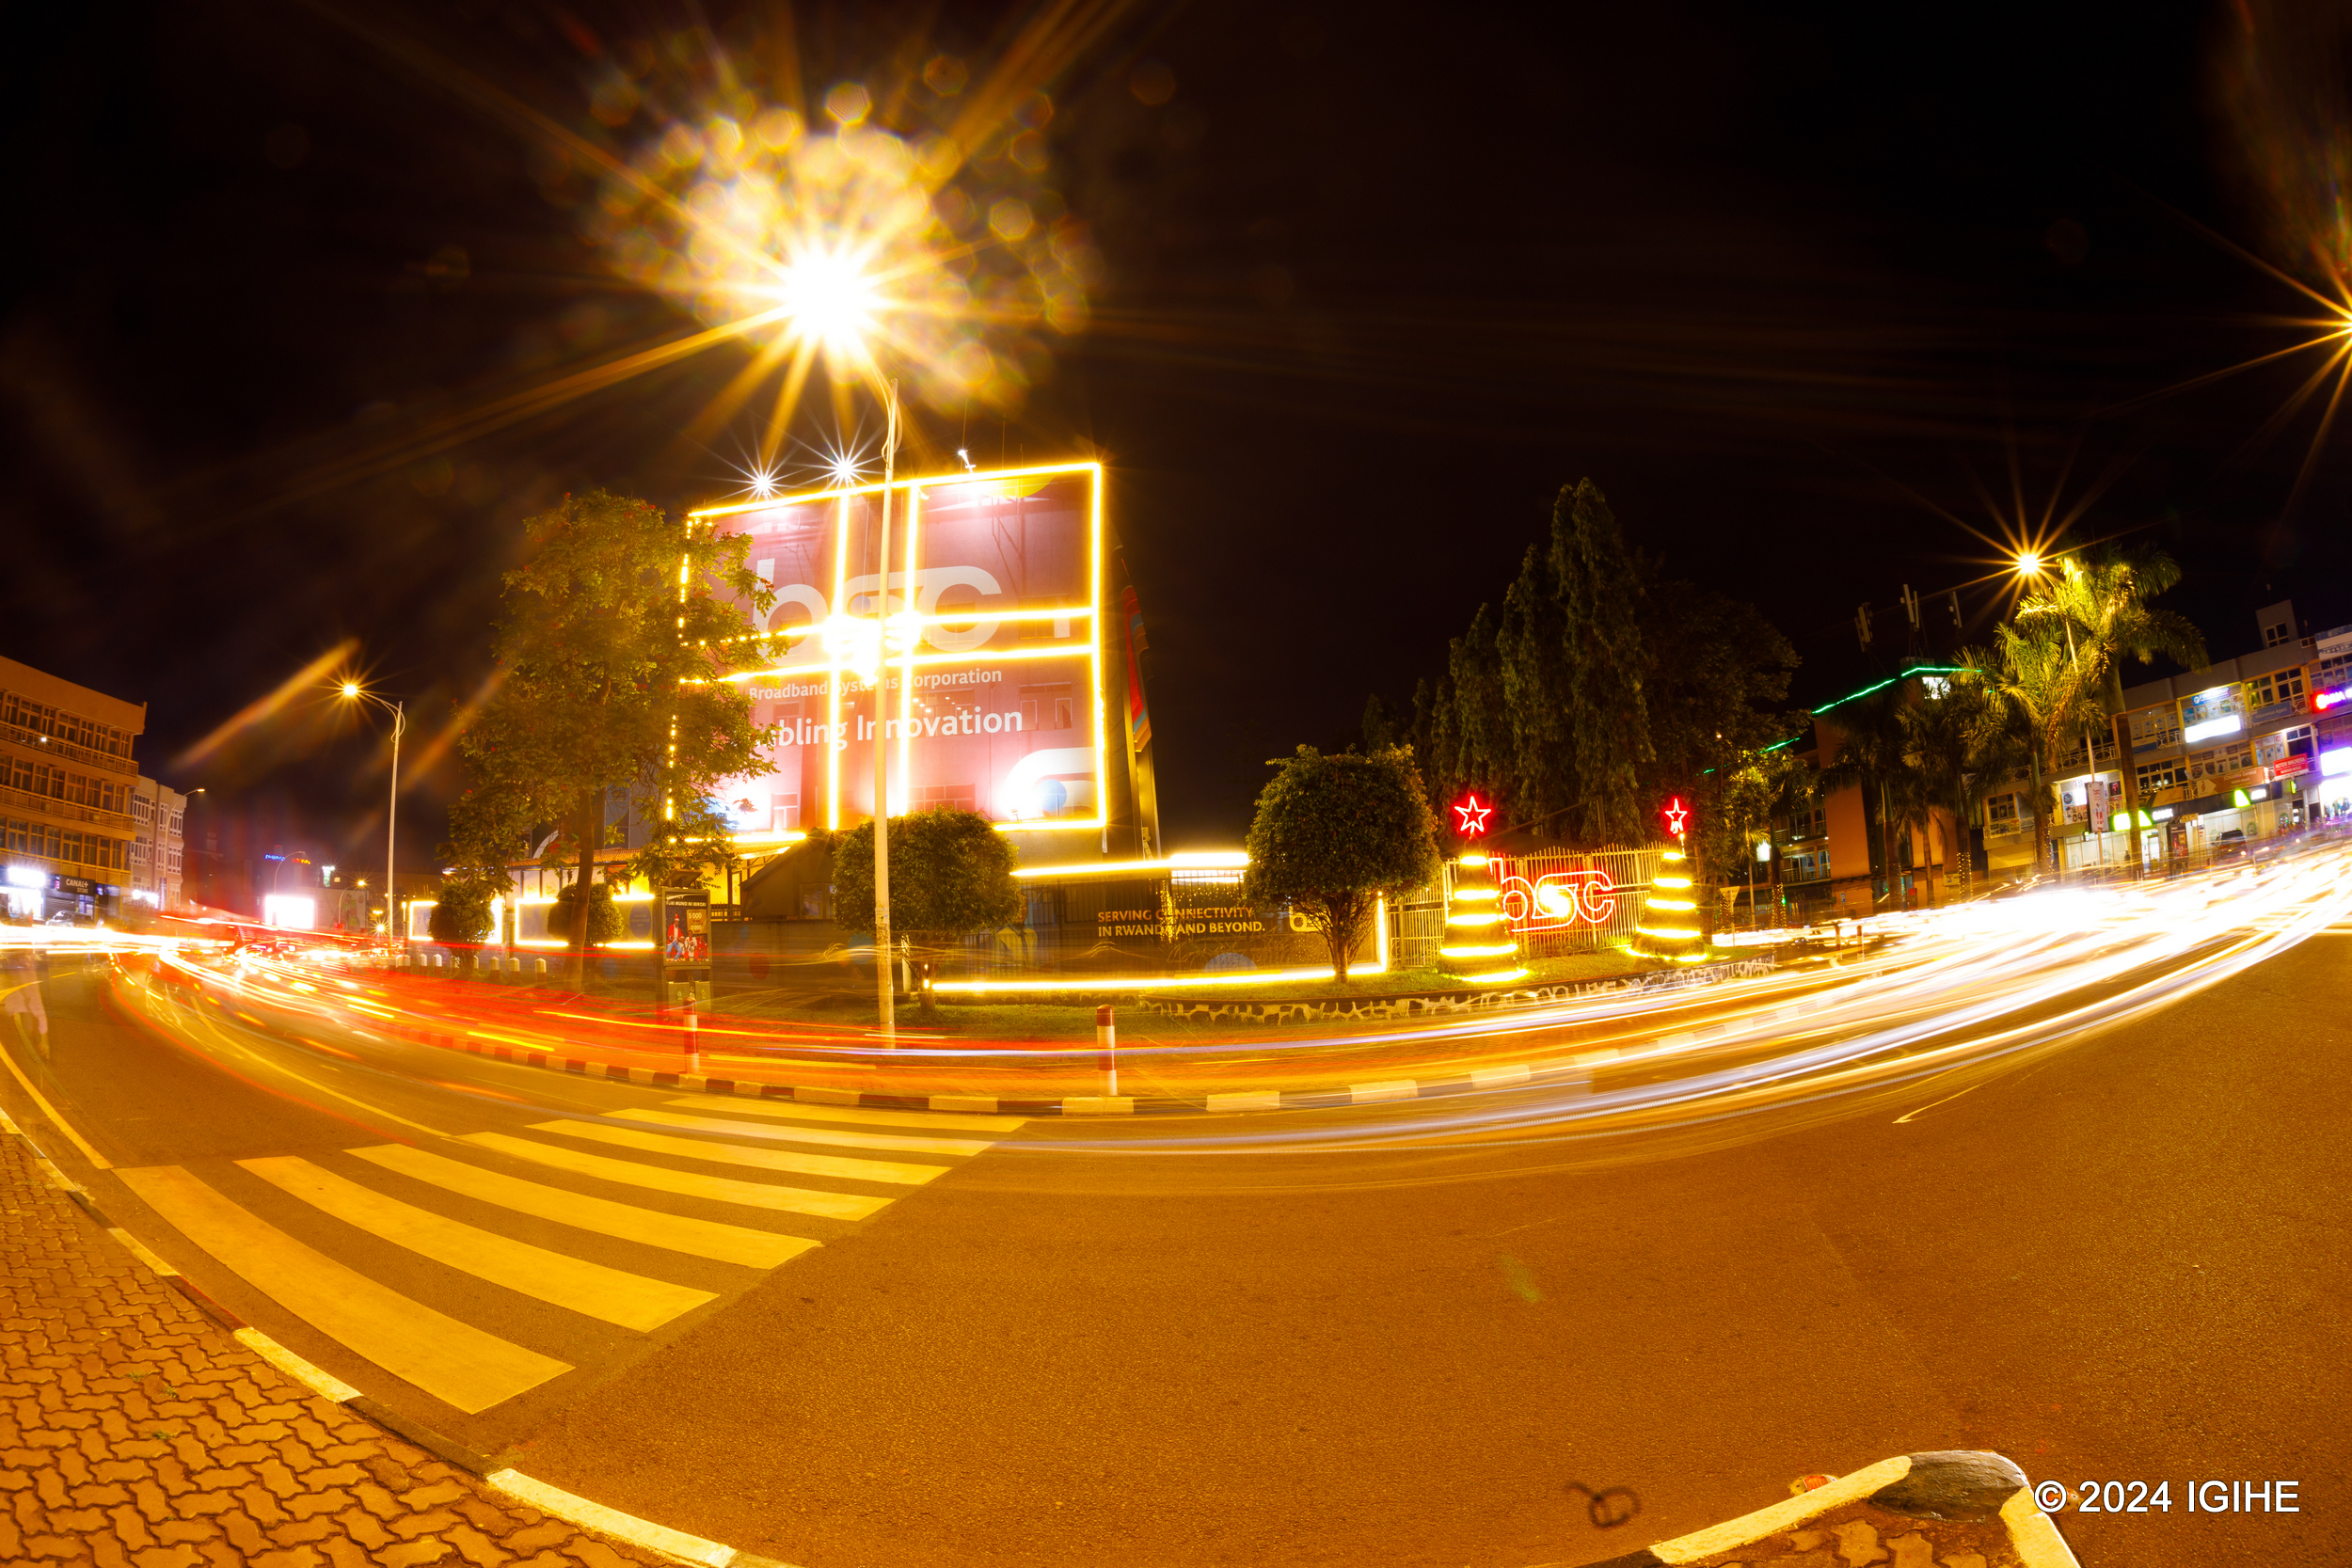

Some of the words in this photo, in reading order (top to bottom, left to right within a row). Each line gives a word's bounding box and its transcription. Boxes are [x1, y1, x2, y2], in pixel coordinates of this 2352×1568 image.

[749, 680, 828, 700] Broadband
[905, 668, 1002, 689] orporation
[857, 706, 1023, 742] Innovation
[66, 879, 88, 888] CANAL+
[1098, 910, 1152, 923] SERVING
[1155, 907, 1253, 921] CNNECTIVITY
[1098, 926, 1113, 937] IN
[1176, 923, 1206, 935] AND
[1209, 921, 1265, 933] BEYOND.
